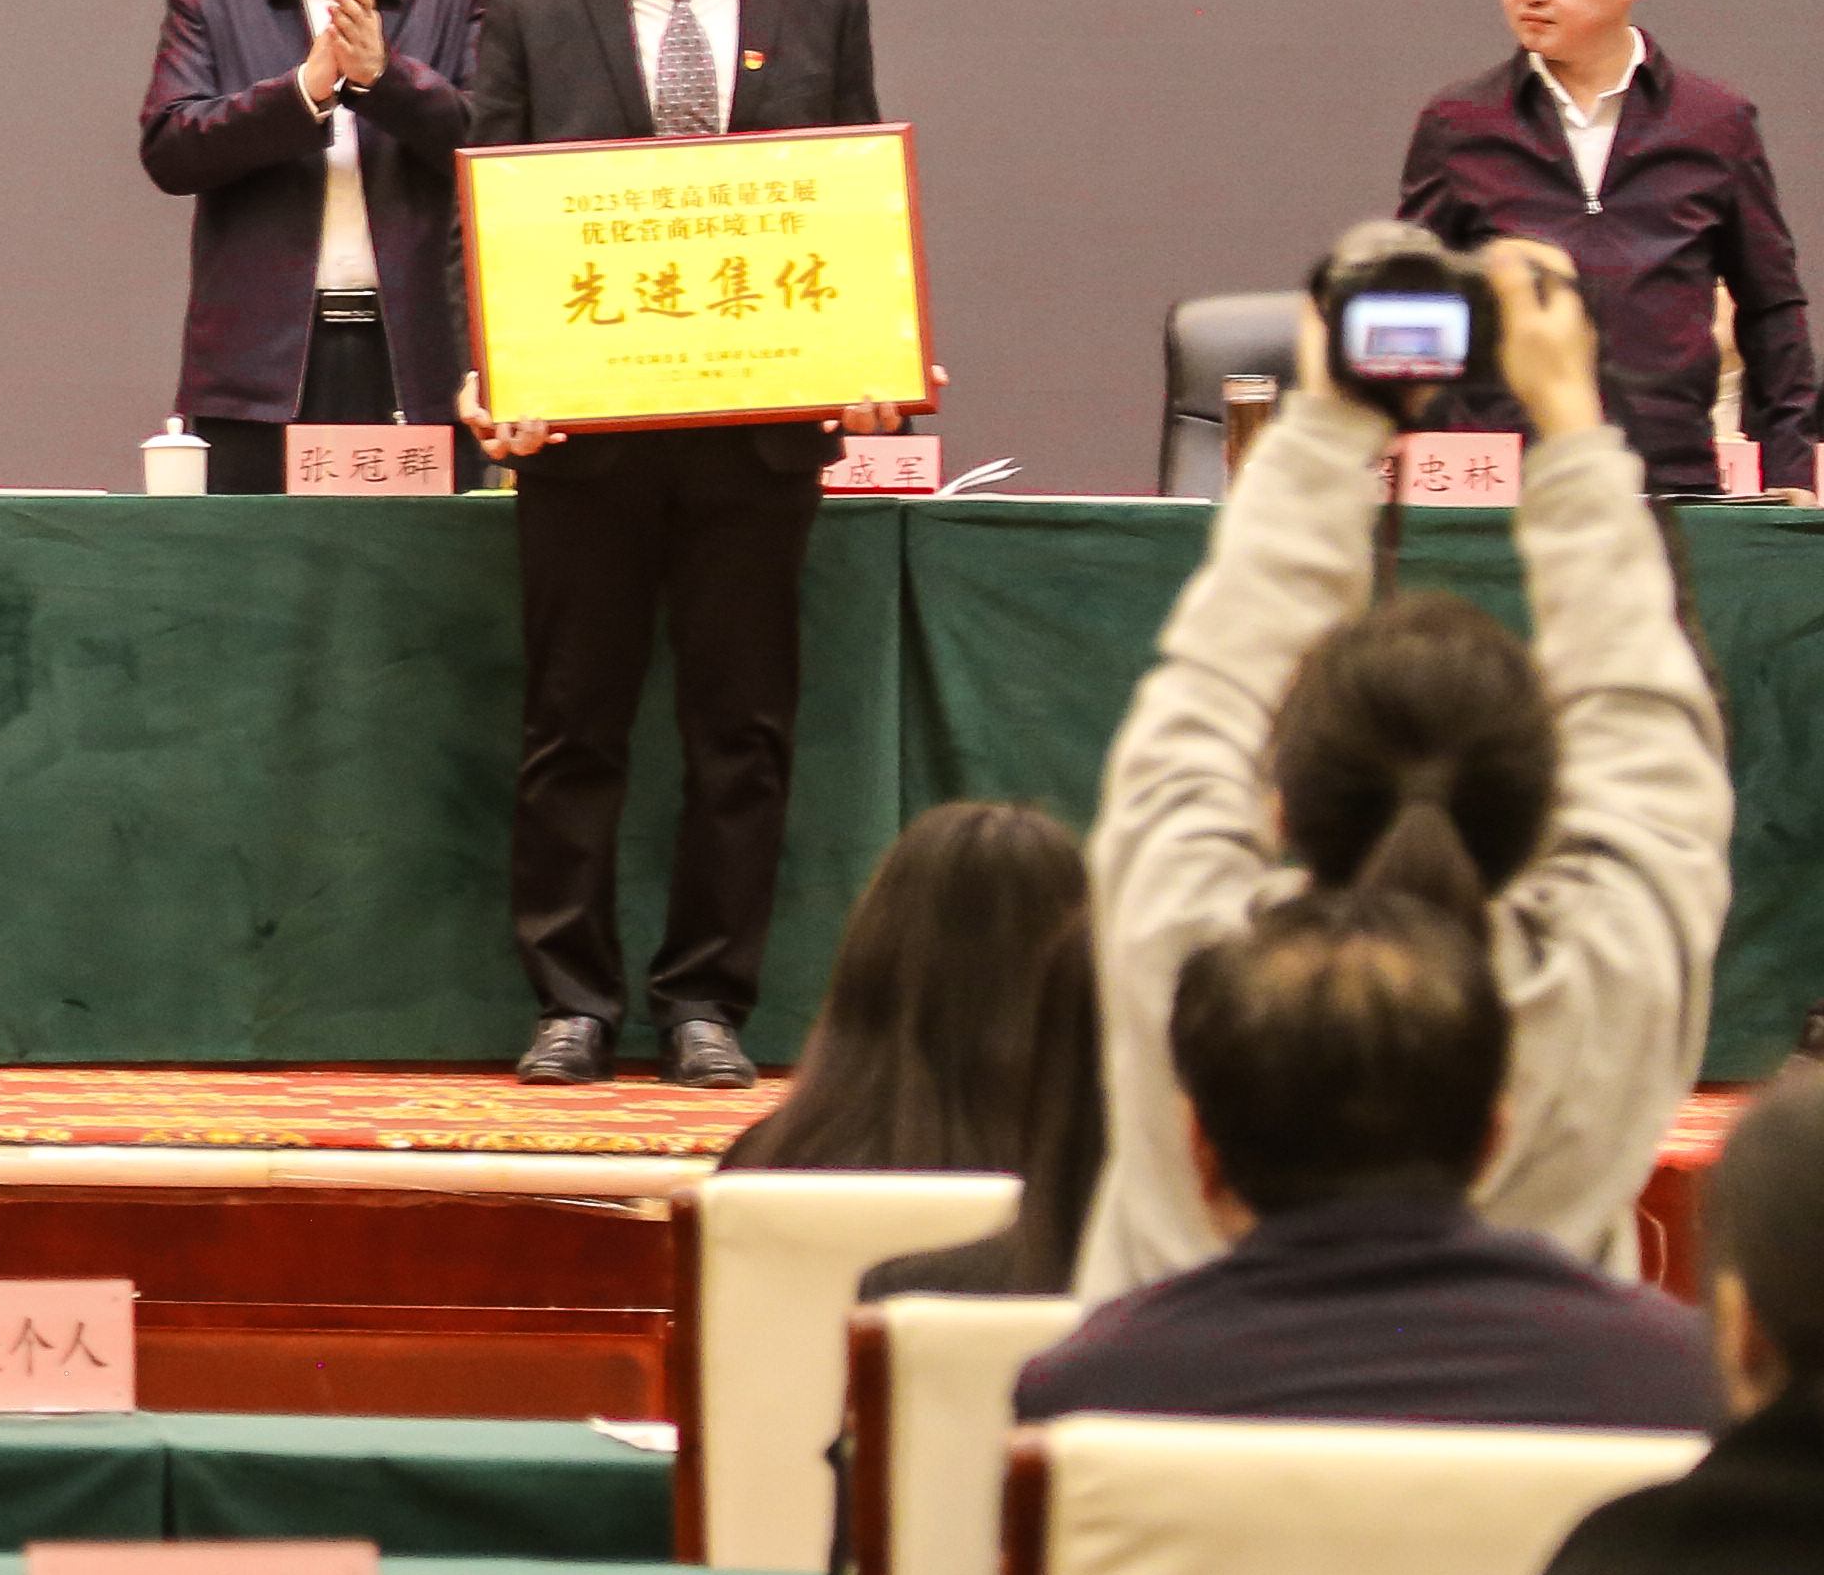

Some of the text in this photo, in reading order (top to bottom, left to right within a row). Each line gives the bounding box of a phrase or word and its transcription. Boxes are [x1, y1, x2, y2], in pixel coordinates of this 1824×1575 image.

[562, 178, 818, 214] 2023年度高质量发展
[581, 211, 807, 245] 优化营商环境工作
[562, 253, 839, 325] 先进集体
[299, 445, 439, 484] 张冠群
[822, 453, 926, 487] 成军
